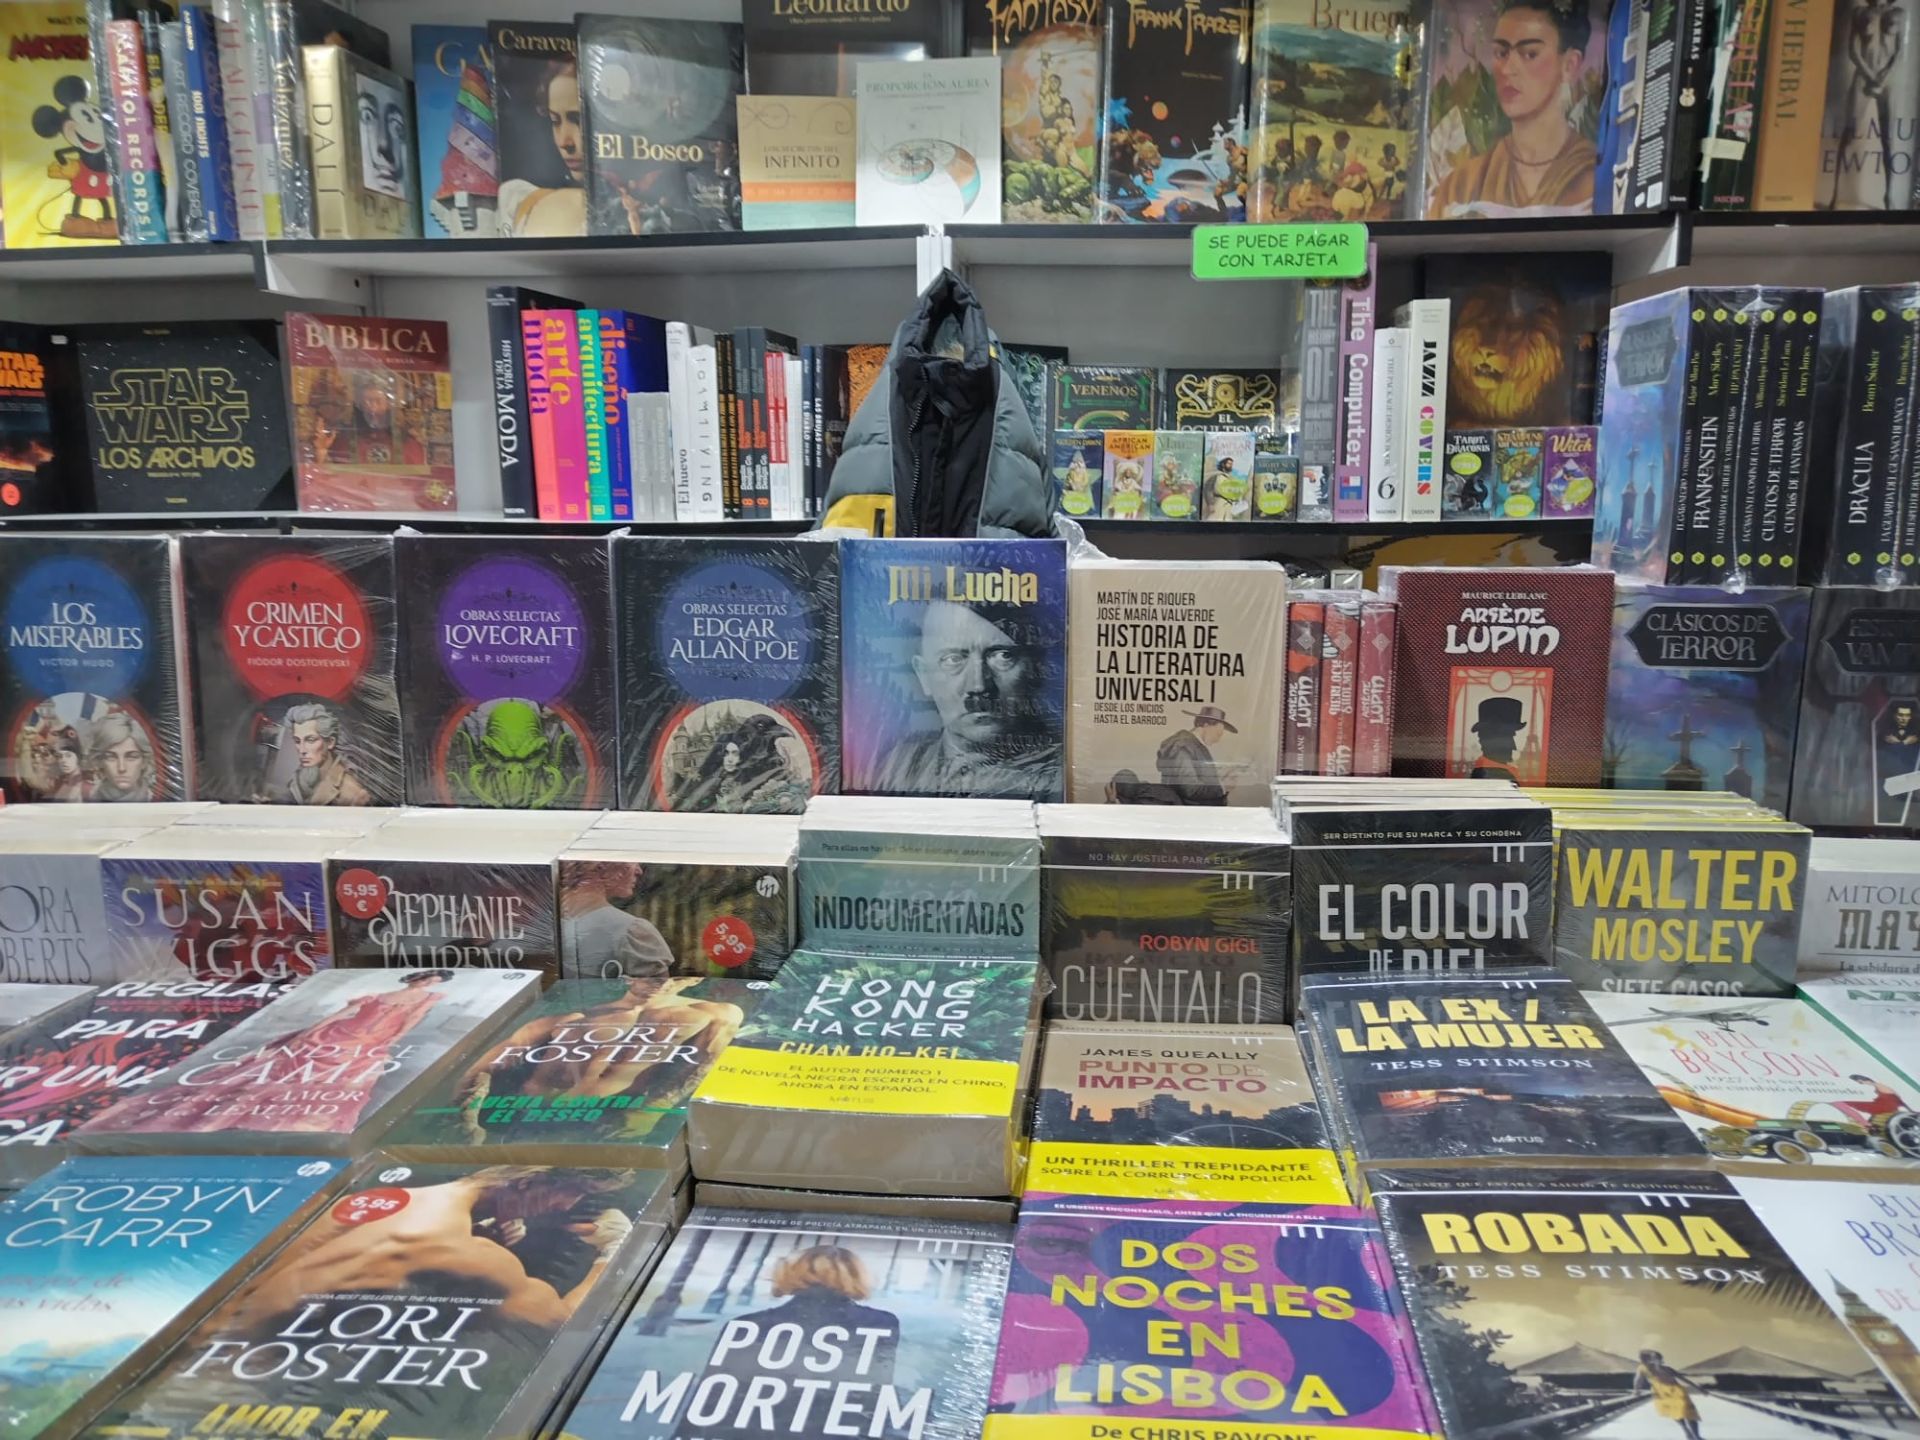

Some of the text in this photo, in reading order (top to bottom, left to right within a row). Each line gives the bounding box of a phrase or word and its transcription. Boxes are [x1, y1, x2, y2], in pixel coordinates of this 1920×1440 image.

[1774, 18, 1807, 128] HERBAL
[598, 134, 703, 162] El Bosco
[764, 154, 840, 170] INFINITO
[1209, 233, 1350, 249] SE PUEDE PAGAR
[1218, 252, 1339, 268] CON TARJETA
[523, 319, 551, 416] moda
[544, 319, 578, 406] arte
[598, 316, 629, 425] diseño
[92, 366, 249, 407] STAR
[1071, 384, 1138, 397] VENENOS
[1343, 297, 1371, 467] The Computer
[578, 317, 604, 475] arquitectura
[1861, 384, 1878, 412] Bram
[96, 405, 251, 443] WARS
[1219, 414, 1233, 424] EL
[1417, 340, 1437, 496] JAZZ COVERS
[497, 393, 519, 470] MODA
[1551, 433, 1593, 453] Witch
[98, 446, 256, 469] LOS ARCHIVOS
[680, 449, 689, 487] huevo
[1692, 415, 1719, 530] FRANKENSTEIN
[1847, 441, 1876, 524] DRÁCULA
[1761, 484, 1778, 542] CUENTOS
[888, 564, 1039, 608] Mi Lucha
[1096, 590, 1196, 607] MARTÍN DE RIQUER
[1505, 591, 1549, 601] LEBLANC
[52, 602, 97, 625] LOS
[246, 602, 344, 624] CRIMEN
[460, 609, 561, 622] OBRAS SELECTAS
[682, 603, 788, 616] OBRAS SELECTAS
[1096, 605, 1215, 623] JOSÉ MARÍA VALVERDE
[1459, 603, 1546, 624] ARSÈNE
[1646, 611, 1769, 633] CLÁSICOS DE
[10, 625, 144, 653] MISERABLES
[233, 625, 362, 654] Y CASTIGO
[444, 623, 579, 648] LOVECRAFT
[693, 617, 776, 640] EDGAR
[1096, 624, 1219, 650] HISTORIA DE
[1444, 624, 1561, 656] LUPIN
[496, 654, 551, 664] LOVECRAFT
[670, 638, 800, 664] ALLAN POE
[1656, 634, 1757, 662] TERROR
[39, 657, 115, 668] VICTOR HUGO
[1096, 651, 1246, 678] LA LITERATURA
[1095, 676, 1204, 704] UNIVERSAL
[1342, 832, 1385, 840] DISTINTO
[1129, 854, 1211, 865] JUSTICIA PARA
[342, 883, 379, 898] 5,95
[1566, 847, 1797, 912] WALTER
[120, 886, 314, 933] SUSAN
[356, 900, 368, 912] €
[368, 876, 525, 945] STEPHANIE
[813, 895, 1025, 938] INDOCUMENTADAS
[1318, 882, 1529, 941] EL COLOR
[712, 942, 725, 956] €
[1139, 935, 1212, 953] ROBYN
[1590, 917, 1764, 964] MOSLEY
[1839, 961, 1855, 972] La
[816, 975, 977, 1000] HONG
[804, 995, 972, 1020] KONG
[1357, 999, 1513, 1024] LA EX
[53, 1019, 217, 1040] PARA
[548, 1027, 683, 1045] LORI
[791, 1017, 967, 1039] HACKER
[1335, 1024, 1605, 1053] LA MUJER
[212, 1043, 421, 1062] CANDACE
[490, 1045, 700, 1065] FOSTER
[1080, 1048, 1260, 1061] JAMES QUEALLY
[1371, 1057, 1594, 1072] TESS STIMSON
[1670, 1048, 1841, 1078] BRYSON
[178, 1060, 402, 1087] CAMP
[740, 1068, 859, 1082] NOVELA NEGRA
[1078, 1060, 1265, 1078] PUNTO DE
[1077, 1074, 1269, 1094] IMPACTO
[516, 1109, 603, 1123] DESEO
[1040, 1167, 1317, 1184] SOBRE CORRUPCIÓN POLICIAL
[1045, 1156, 1312, 1173] UN THRILLER TREPIDANTE
[21, 1185, 283, 1214] ROBYN
[349, 1195, 399, 1211] 5,95
[4, 1217, 213, 1248] CARR
[1420, 1212, 1751, 1259] ROBADA
[1121, 1238, 1260, 1273] DOS
[1437, 1265, 1766, 1284] TESS STIMSON
[1050, 1274, 1357, 1320] NOCHES
[276, 1302, 482, 1343] LORI
[708, 1319, 893, 1375] POST
[1146, 1319, 1241, 1359] EN
[181, 1341, 489, 1390] FOSTER
[1054, 1363, 1349, 1418] LISBOA
[619, 1369, 935, 1440] MORTEM
[194, 1402, 326, 1436] AMOR
[1091, 1424, 1123, 1439] De
